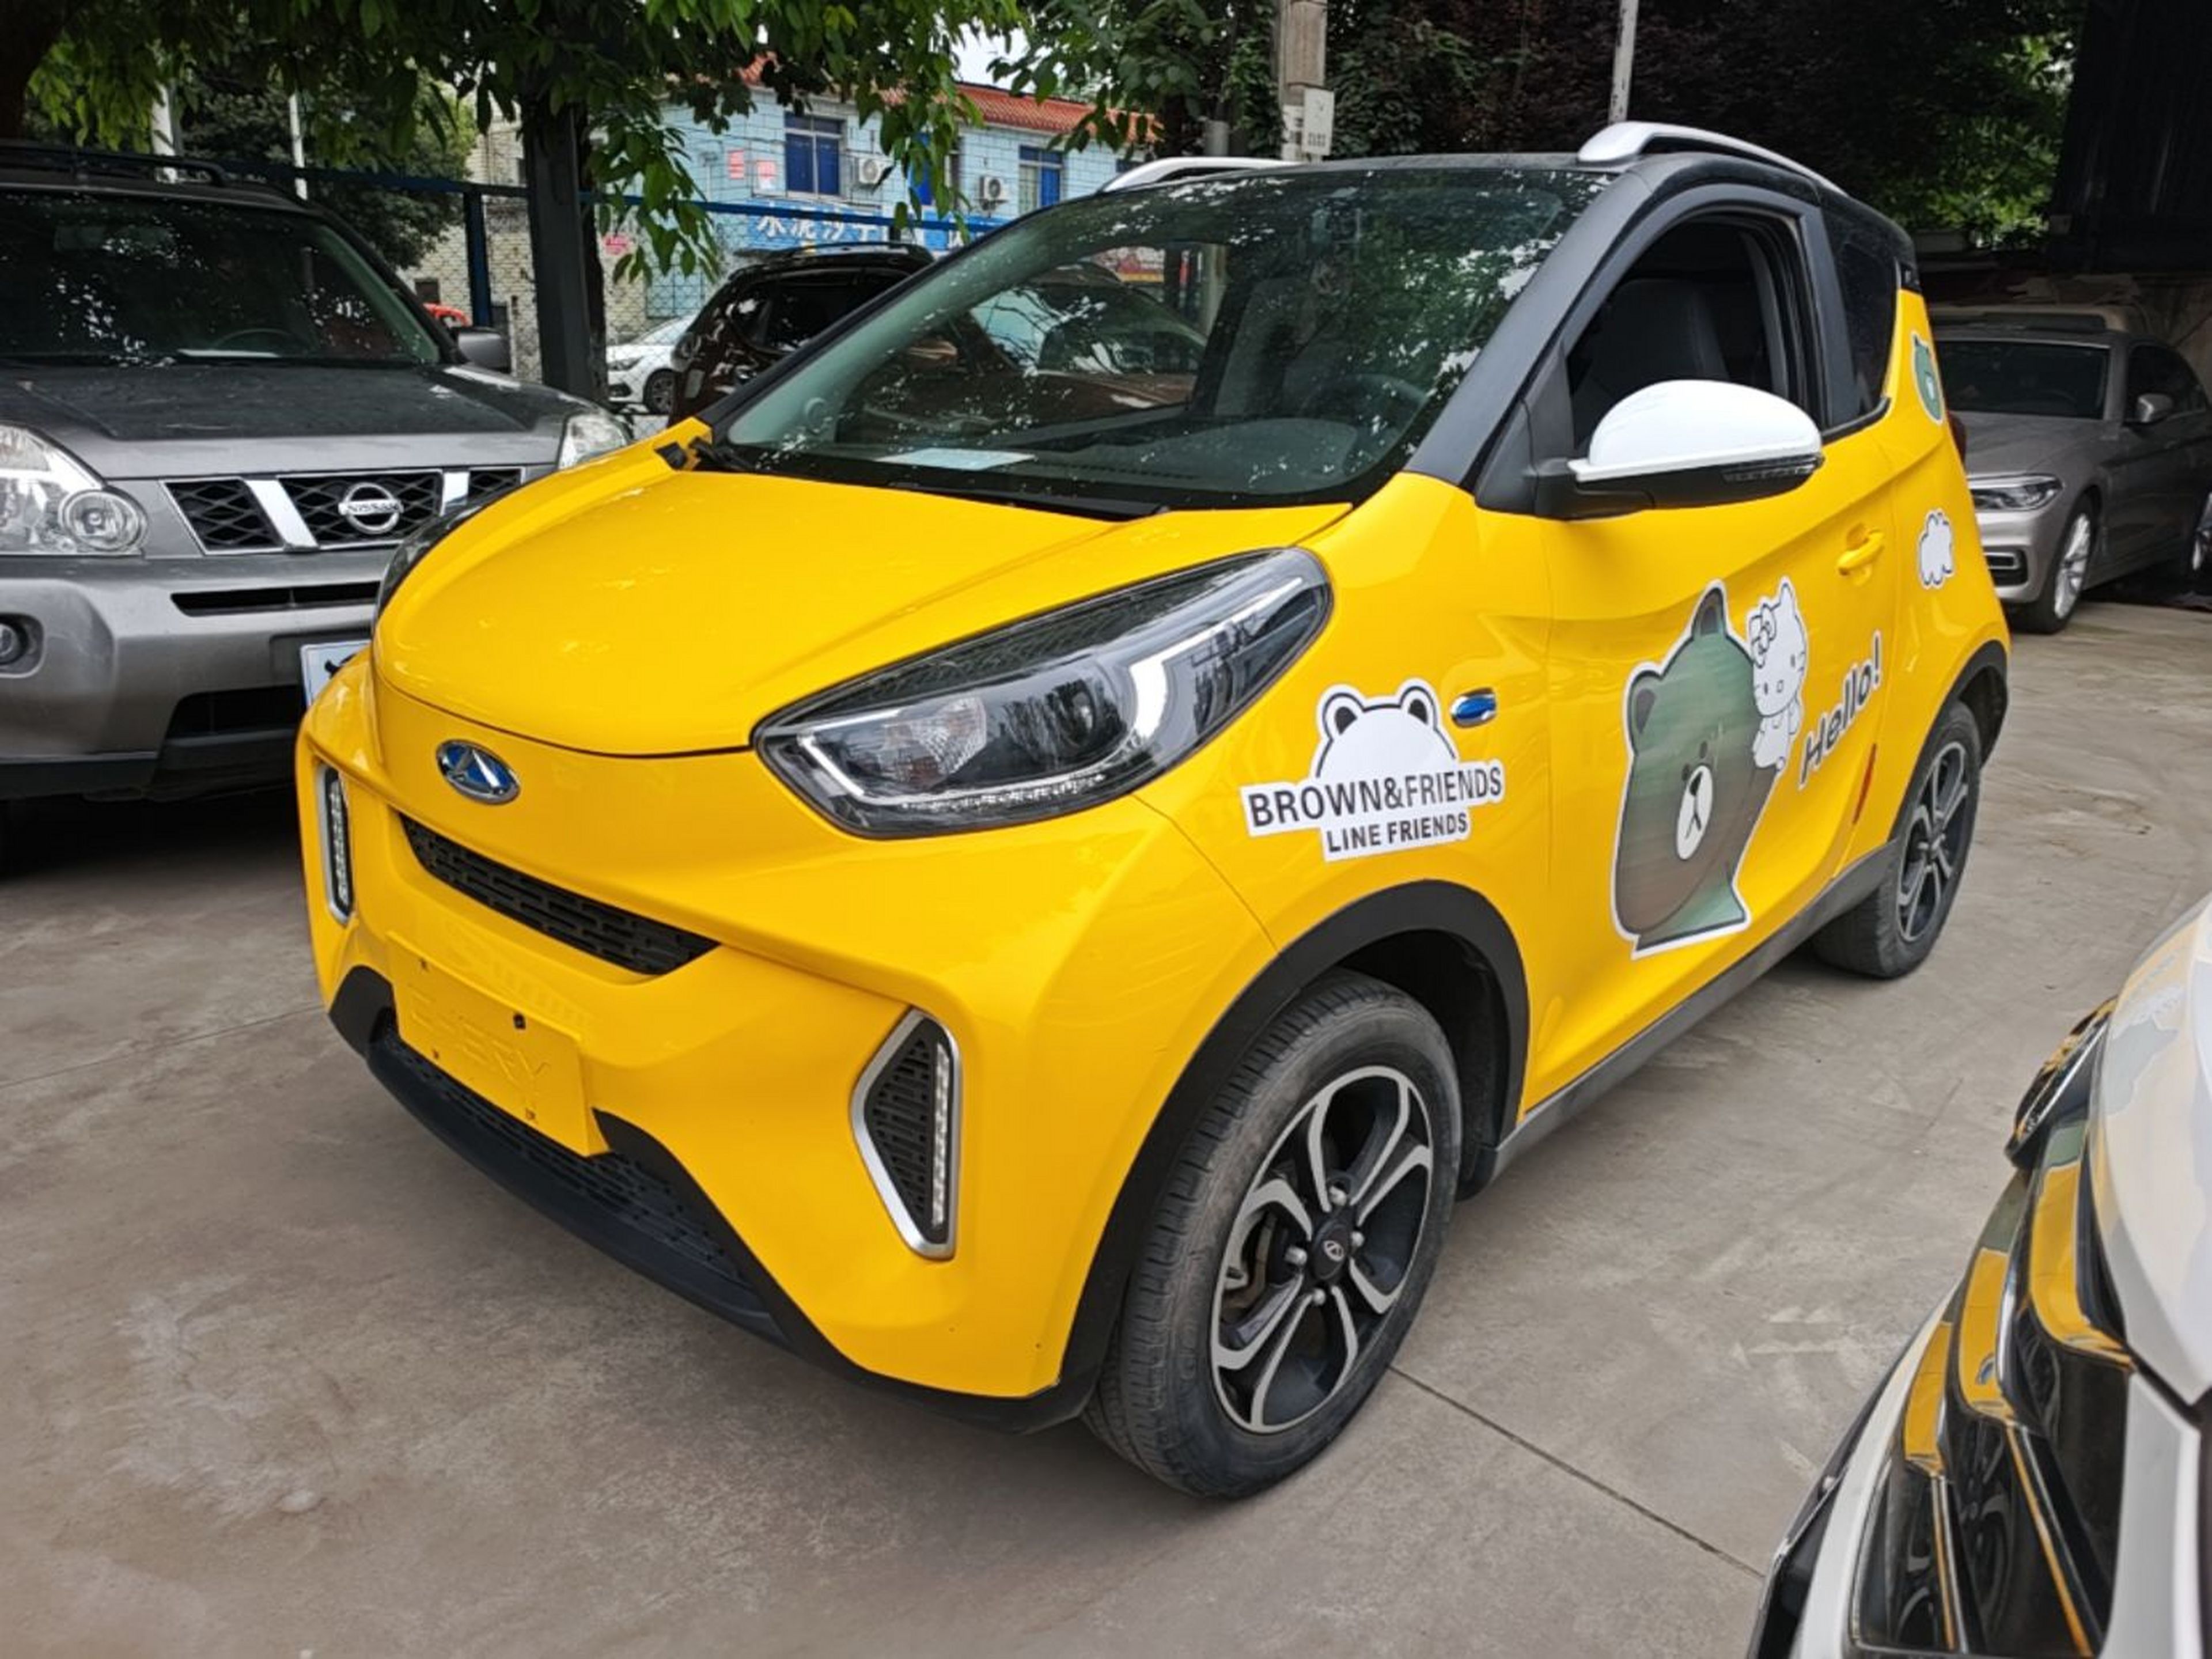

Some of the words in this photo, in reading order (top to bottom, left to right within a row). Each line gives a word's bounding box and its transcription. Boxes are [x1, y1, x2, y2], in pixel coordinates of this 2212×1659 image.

[1800, 634, 1880, 785] Hello!
[1248, 766, 1502, 828] BROWN&FRIENDS
[1327, 824, 1381, 853] LINE
[1388, 813, 1468, 844] FRIENDS
